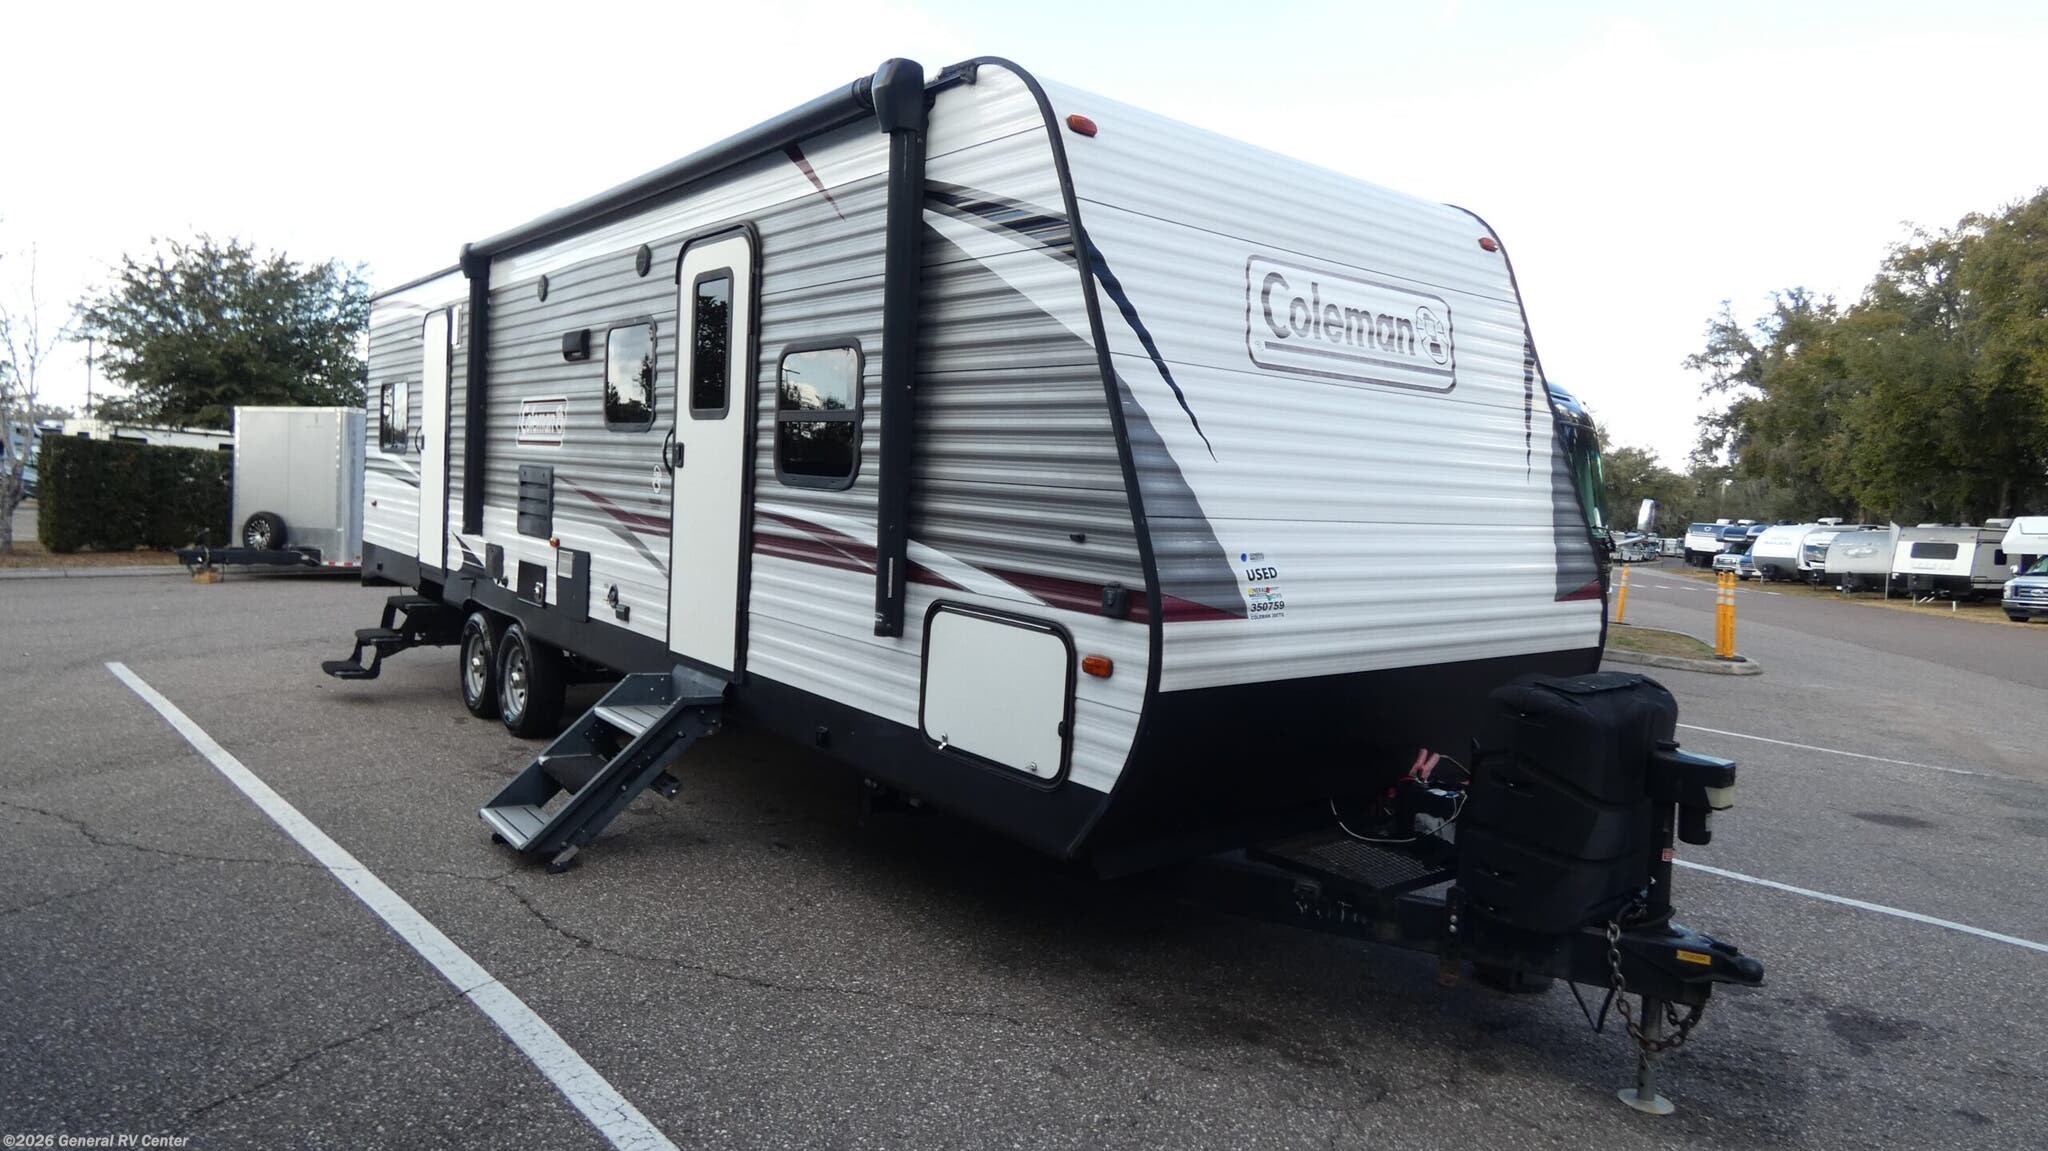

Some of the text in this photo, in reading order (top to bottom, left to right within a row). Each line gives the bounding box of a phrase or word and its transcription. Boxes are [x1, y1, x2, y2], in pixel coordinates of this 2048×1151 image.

[1261, 272, 1415, 356] Coleman
[1246, 567, 1277, 581] USED
[1251, 601, 1285, 612] 350759
